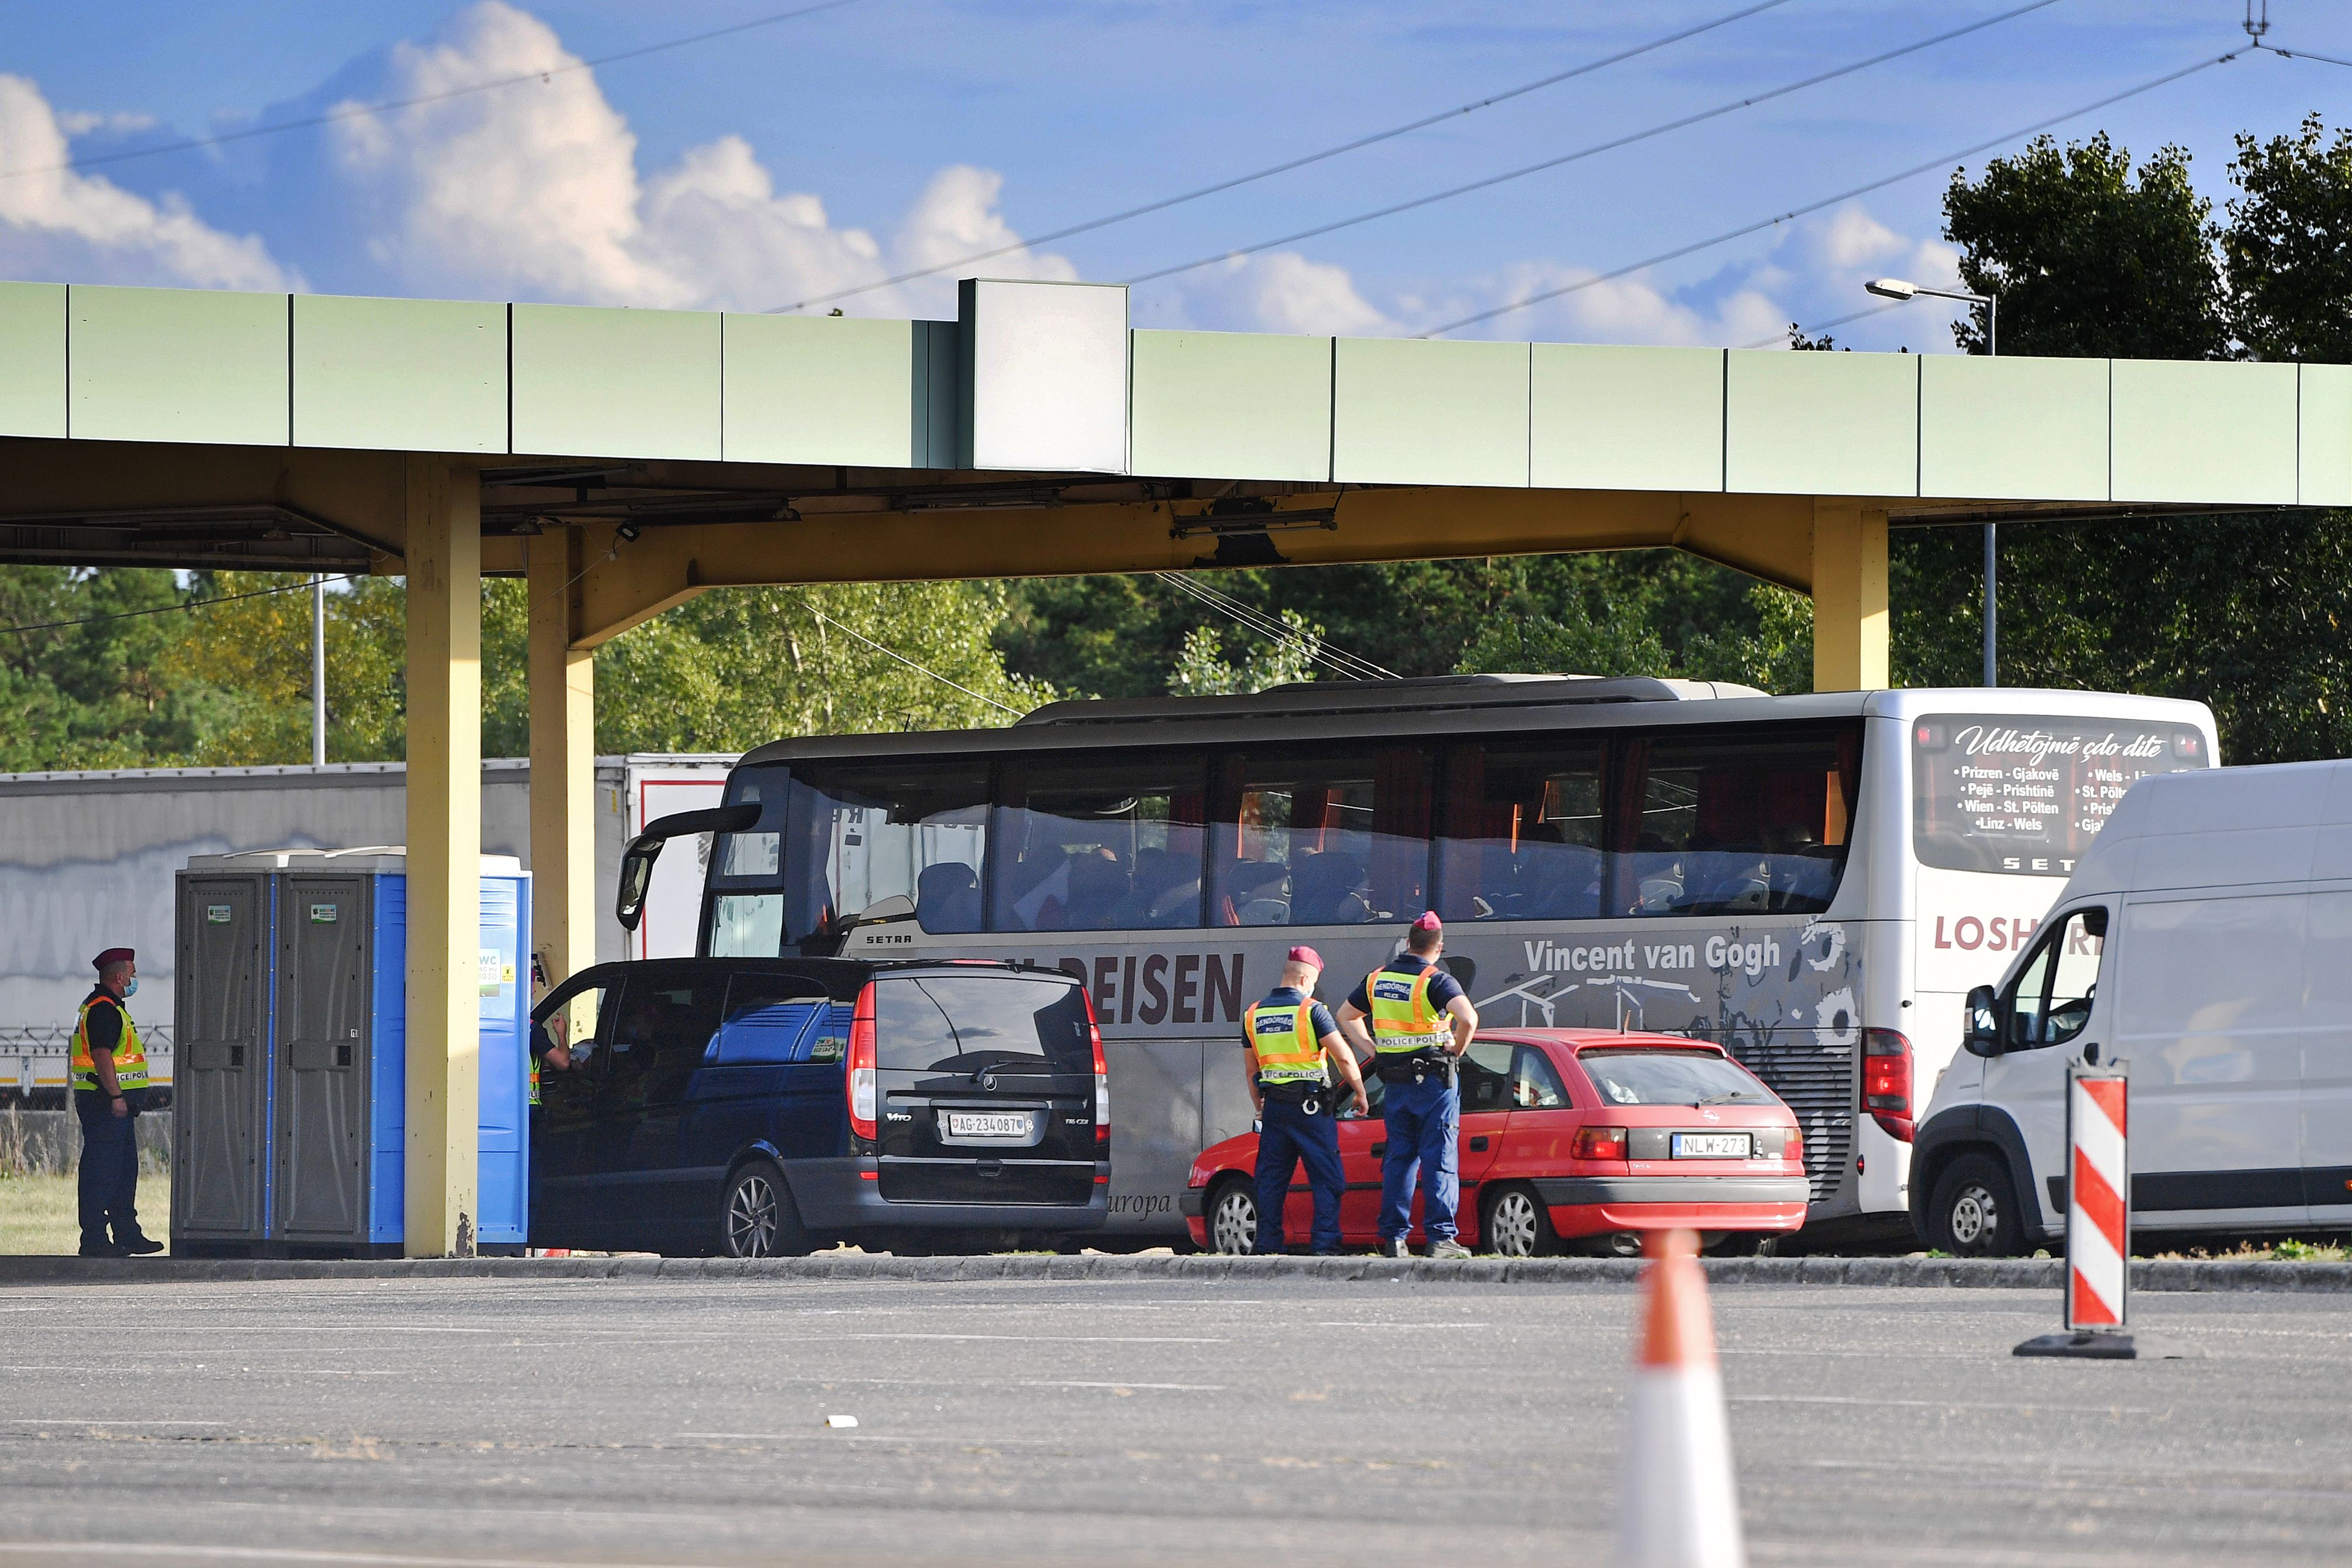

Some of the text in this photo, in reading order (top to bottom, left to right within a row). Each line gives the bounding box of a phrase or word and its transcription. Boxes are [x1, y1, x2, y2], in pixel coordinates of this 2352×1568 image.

[1955, 726, 2167, 766] Udhëtojmë çdo ditë
[1961, 765, 2003, 779] Prizren
[2012, 767, 2060, 783] Gjakovë
[2094, 768, 2123, 782] Wels
[1967, 783, 1994, 798] Pejë
[2003, 783, 2054, 798] Prishtinë
[1964, 799, 1994, 813] Wien
[2022, 801, 2059, 814] Pölten
[1980, 817, 2005, 830] Linz
[2013, 817, 2042, 831] Wels
[2003, 857, 2076, 872] SET
[866, 935, 911, 944] SETRA
[1935, 916, 2050, 955] LOSH
[1524, 934, 1780, 977] Vincent van Gogh
[1382, 1038, 1412, 1046] POLICE
[1684, 1138, 1746, 1154] NLW-273
[1108, 1195, 1171, 1222] uropa
